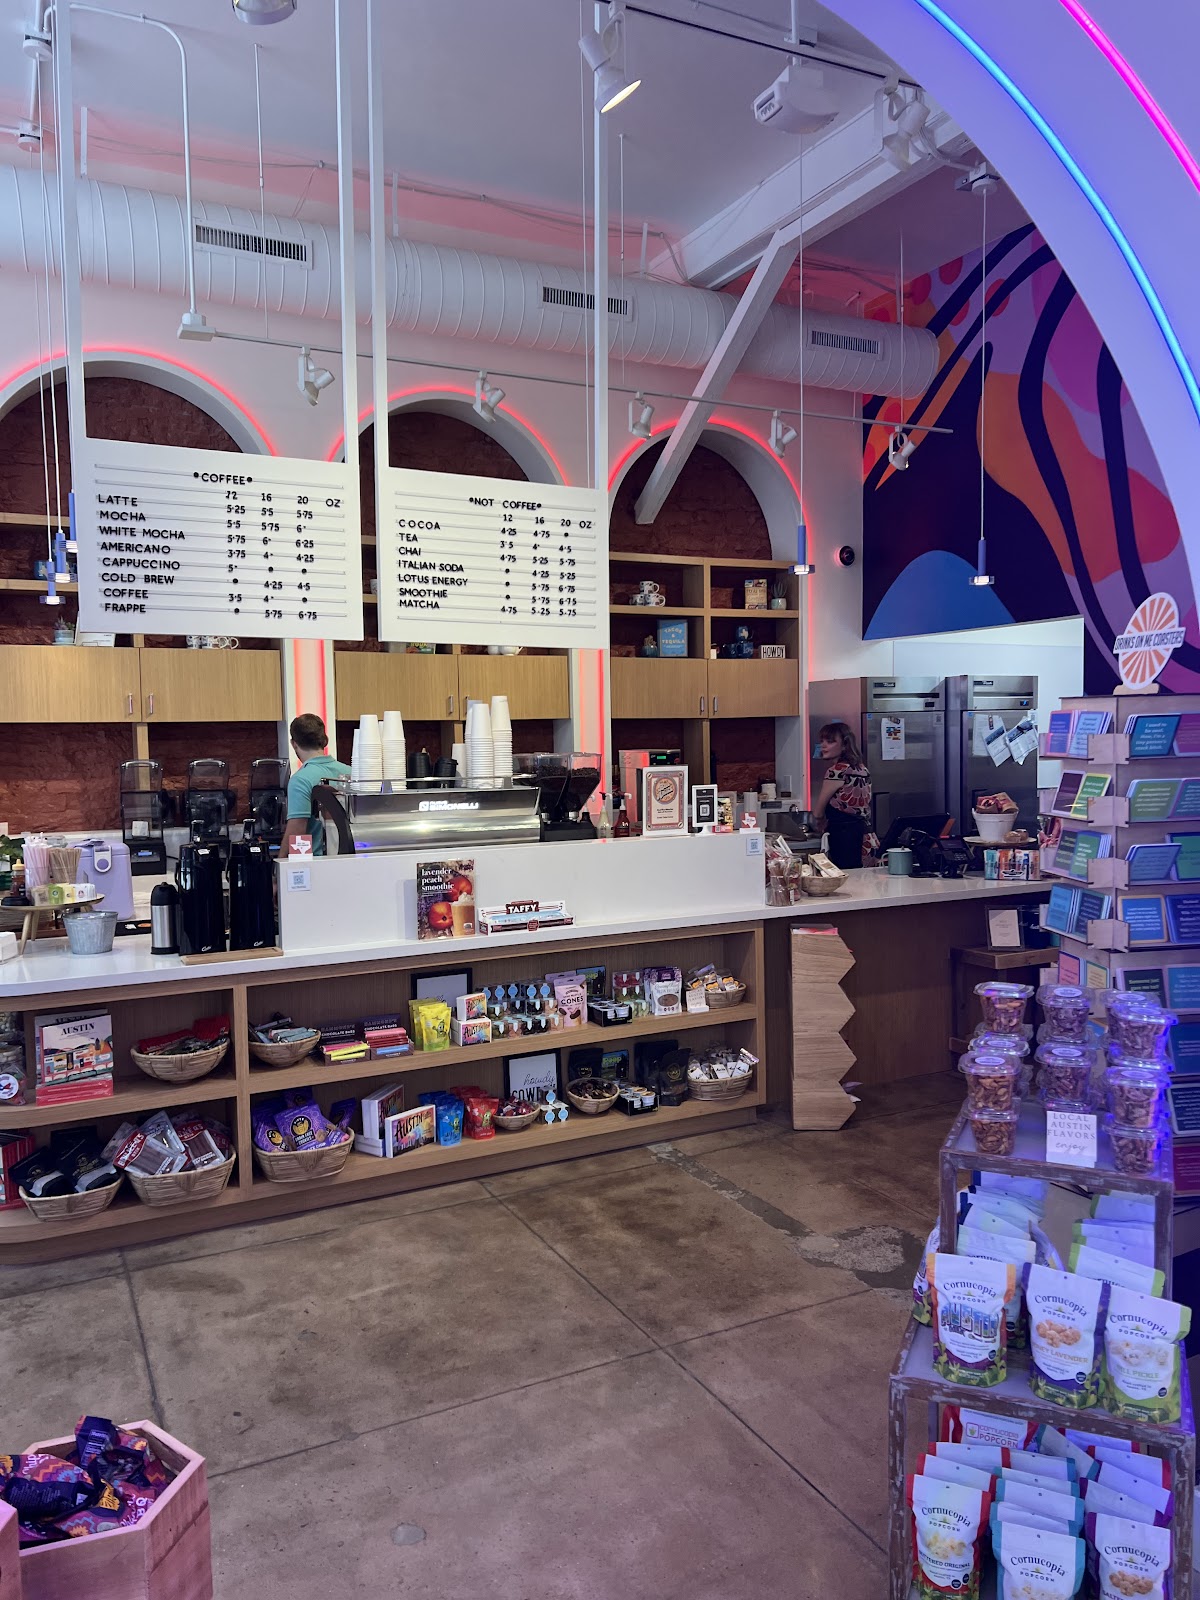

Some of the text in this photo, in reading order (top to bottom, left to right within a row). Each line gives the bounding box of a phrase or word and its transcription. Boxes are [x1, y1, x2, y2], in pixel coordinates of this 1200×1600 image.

[201, 473, 245, 485] COFFEE
[98, 494, 137, 506] LATTE
[226, 491, 340, 507] 12 16 20 OZ
[475, 498, 537, 510] NOT COFFEE
[100, 510, 146, 521] MOCHA
[399, 519, 440, 529] COCOA
[99, 526, 136, 536] WHITE
[143, 529, 185, 539] MOCHA
[399, 533, 418, 541] TEA
[101, 542, 171, 554] AMERICANO
[399, 547, 421, 556] CHAI
[103, 558, 180, 570] CAPPUCCINO
[399, 560, 435, 569] ITALIAN
[439, 563, 463, 572] SODA
[102, 573, 136, 583] COLD
[144, 575, 174, 584] BREW
[398, 574, 429, 584] LOTUS
[432, 577, 468, 586] ENERGY
[104, 588, 149, 598] COFFEE
[400, 588, 447, 597] SMOOTHIE
[105, 603, 146, 613] FRAPPE
[400, 600, 439, 608] MATCHA
[1115, 636, 1135, 650] DRINKS
[1135, 635, 1144, 648] ON
[1144, 634, 1153, 647] ME
[762, 646, 785, 658] HOWDY
[422, 868, 452, 876] lavender
[422, 876, 442, 885] peach
[422, 882, 454, 891] smoothie
[508, 904, 537, 914] TAFFY
[561, 996, 584, 1005] CONES
[61, 1022, 95, 1035] AUSTIN
[524, 1071, 555, 1086] howdy
[1053, 1113, 1089, 1121] LOCAL
[395, 1113, 423, 1142] AUSTIN
[1051, 1122, 1091, 1130] AUSTIN
[1048, 1130, 1095, 1139] FLAVORS
[1056, 1143, 1088, 1154] enjoy
[943, 1281, 996, 1298] Cornucopia
[952, 1295, 986, 1304] POPCORN
[1035, 1294, 1087, 1317] Cornucopia
[1042, 1309, 1075, 1321] POPCORN
[1110, 1314, 1168, 1337] Cornucopia
[1118, 1328, 1155, 1340] POPCORN
[1050, 1348, 1088, 1363] LAVENDER
[1133, 1370, 1159, 1379] PICKLE
[980, 1425, 1019, 1438] cornucopia
[980, 1434, 1018, 1448] POPCORN
[922, 1507, 971, 1527] Cornucopia
[929, 1521, 960, 1532] POPCORN
[1104, 1546, 1160, 1567] Cornucopia
[1011, 1556, 1066, 1577] Cornucopia
[1114, 1561, 1149, 1572] POPCORN
[1020, 1571, 1055, 1582] POPCORN
